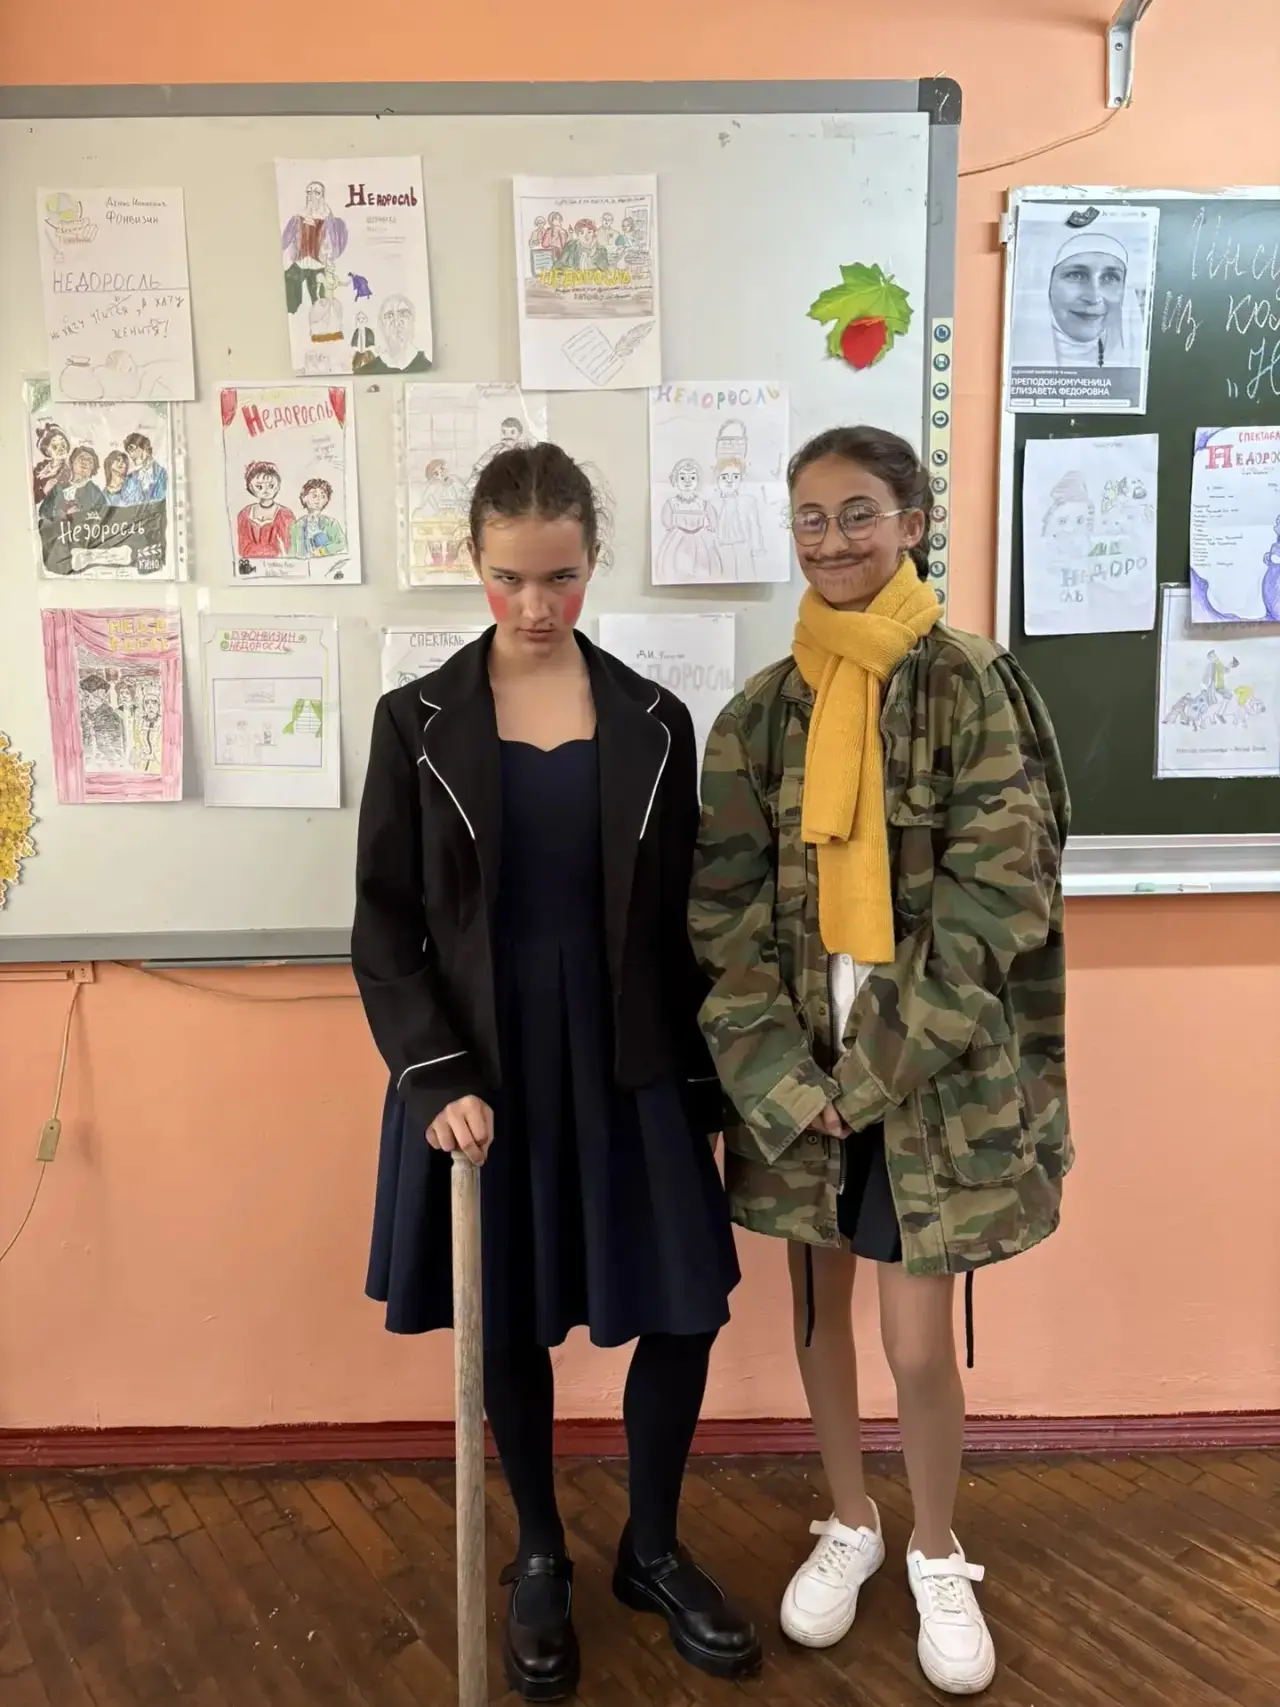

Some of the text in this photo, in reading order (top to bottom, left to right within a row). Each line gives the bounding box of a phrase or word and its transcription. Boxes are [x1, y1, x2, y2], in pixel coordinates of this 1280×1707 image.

[53, 270, 161, 293] НЕДОРОСЛЬ
[1011, 377, 1112, 387] ПРЕПОДОБНОМУЧЕНИЦА
[1011, 386, 1110, 396] ЕЛИЗАВЕТА ФЕДОРОВНА
[409, 633, 465, 648] СПЕКТАКЛЬ
